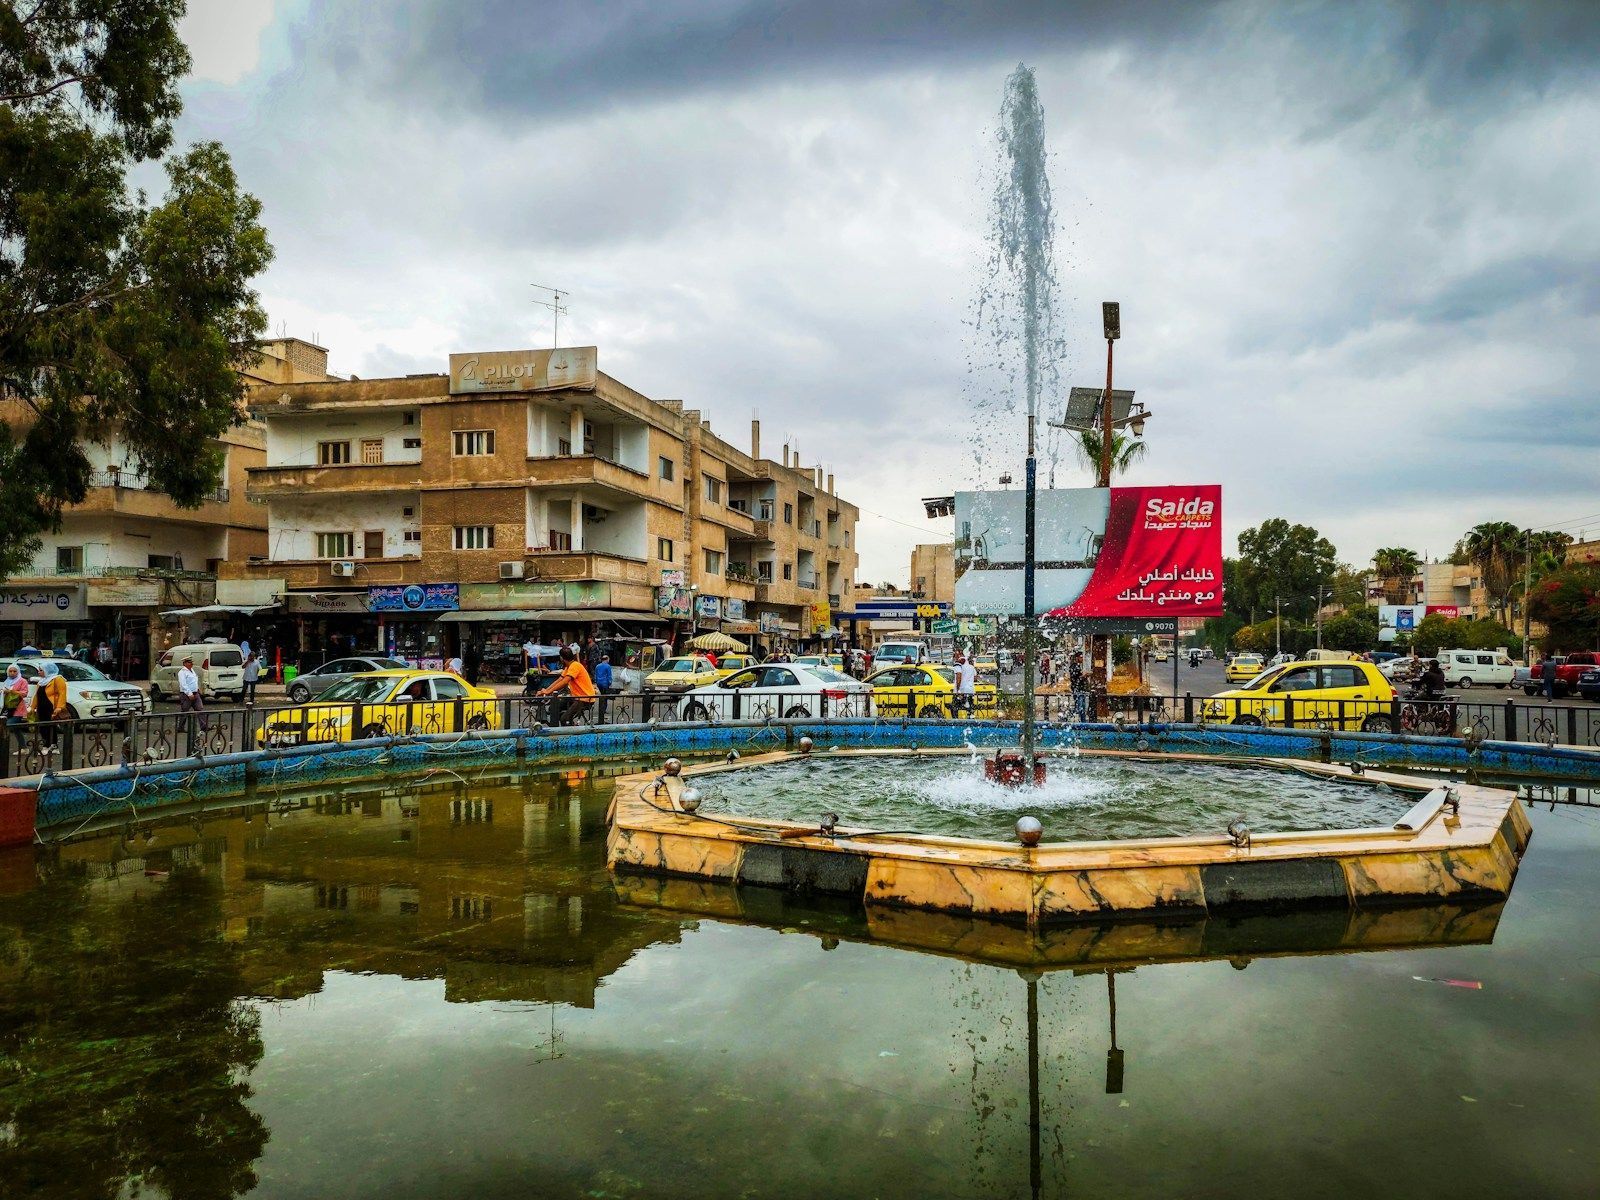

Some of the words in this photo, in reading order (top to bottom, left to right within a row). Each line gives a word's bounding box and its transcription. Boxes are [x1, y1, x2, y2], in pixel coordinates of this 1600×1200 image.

[484, 362, 536, 379] PILOT
[1146, 497, 1214, 516] Saida
[1144, 521, 1178, 531] صيدا
[1178, 520, 1212, 530] سجاد
[1139, 564, 1178, 585] أصلي
[1181, 568, 1214, 582] خليك
[10, 592, 54, 607] الشركة
[508, 584, 564, 601] مكتبة
[1117, 588, 1154, 603] بلدك
[1157, 589, 1191, 605] منتج
[1194, 591, 1215, 604] مع
[916, 604, 941, 618] K&A
[1155, 622, 1175, 630] 9070
